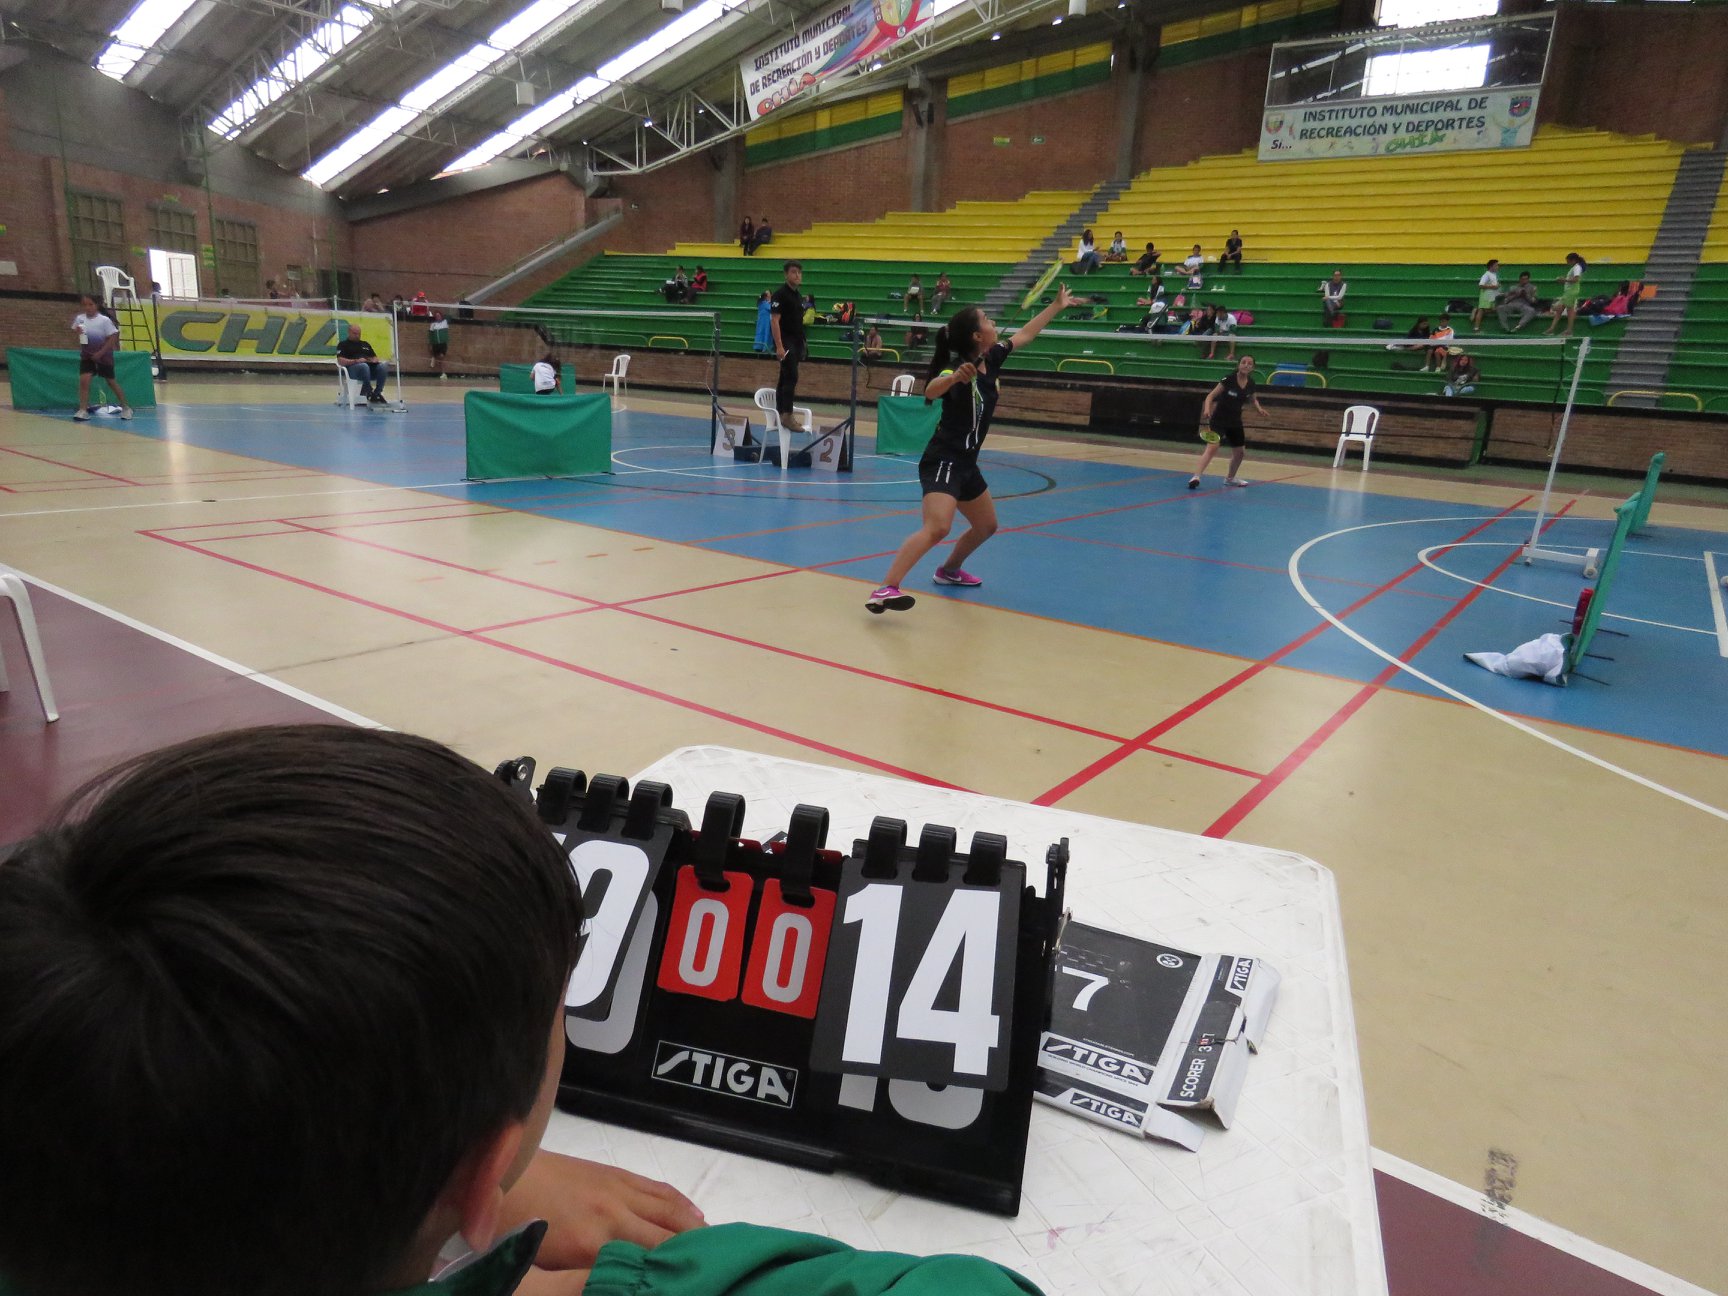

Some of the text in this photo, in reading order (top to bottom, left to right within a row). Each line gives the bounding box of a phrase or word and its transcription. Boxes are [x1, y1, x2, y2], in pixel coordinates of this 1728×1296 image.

[750, 78, 760, 96] DE
[815, 45, 821, 60] Y
[754, 33, 800, 71] INSTITUTO
[1300, 116, 1485, 140] RECREACIÓN Y DEPORTES
[1303, 97, 1489, 123] INSTITUTO MUNICIPAL DE
[820, 437, 834, 463] 2
[678, 898, 729, 987] 0
[761, 912, 814, 1004] 0
[842, 883, 1000, 1076] 14
[1233, 959, 1252, 990] STIGA
[657, 1050, 790, 1104] STIGA
[1046, 1044, 1147, 1083] STIGA
[1180, 1058, 1206, 1098] SCORER
[1072, 1097, 1140, 1126] STIGA
